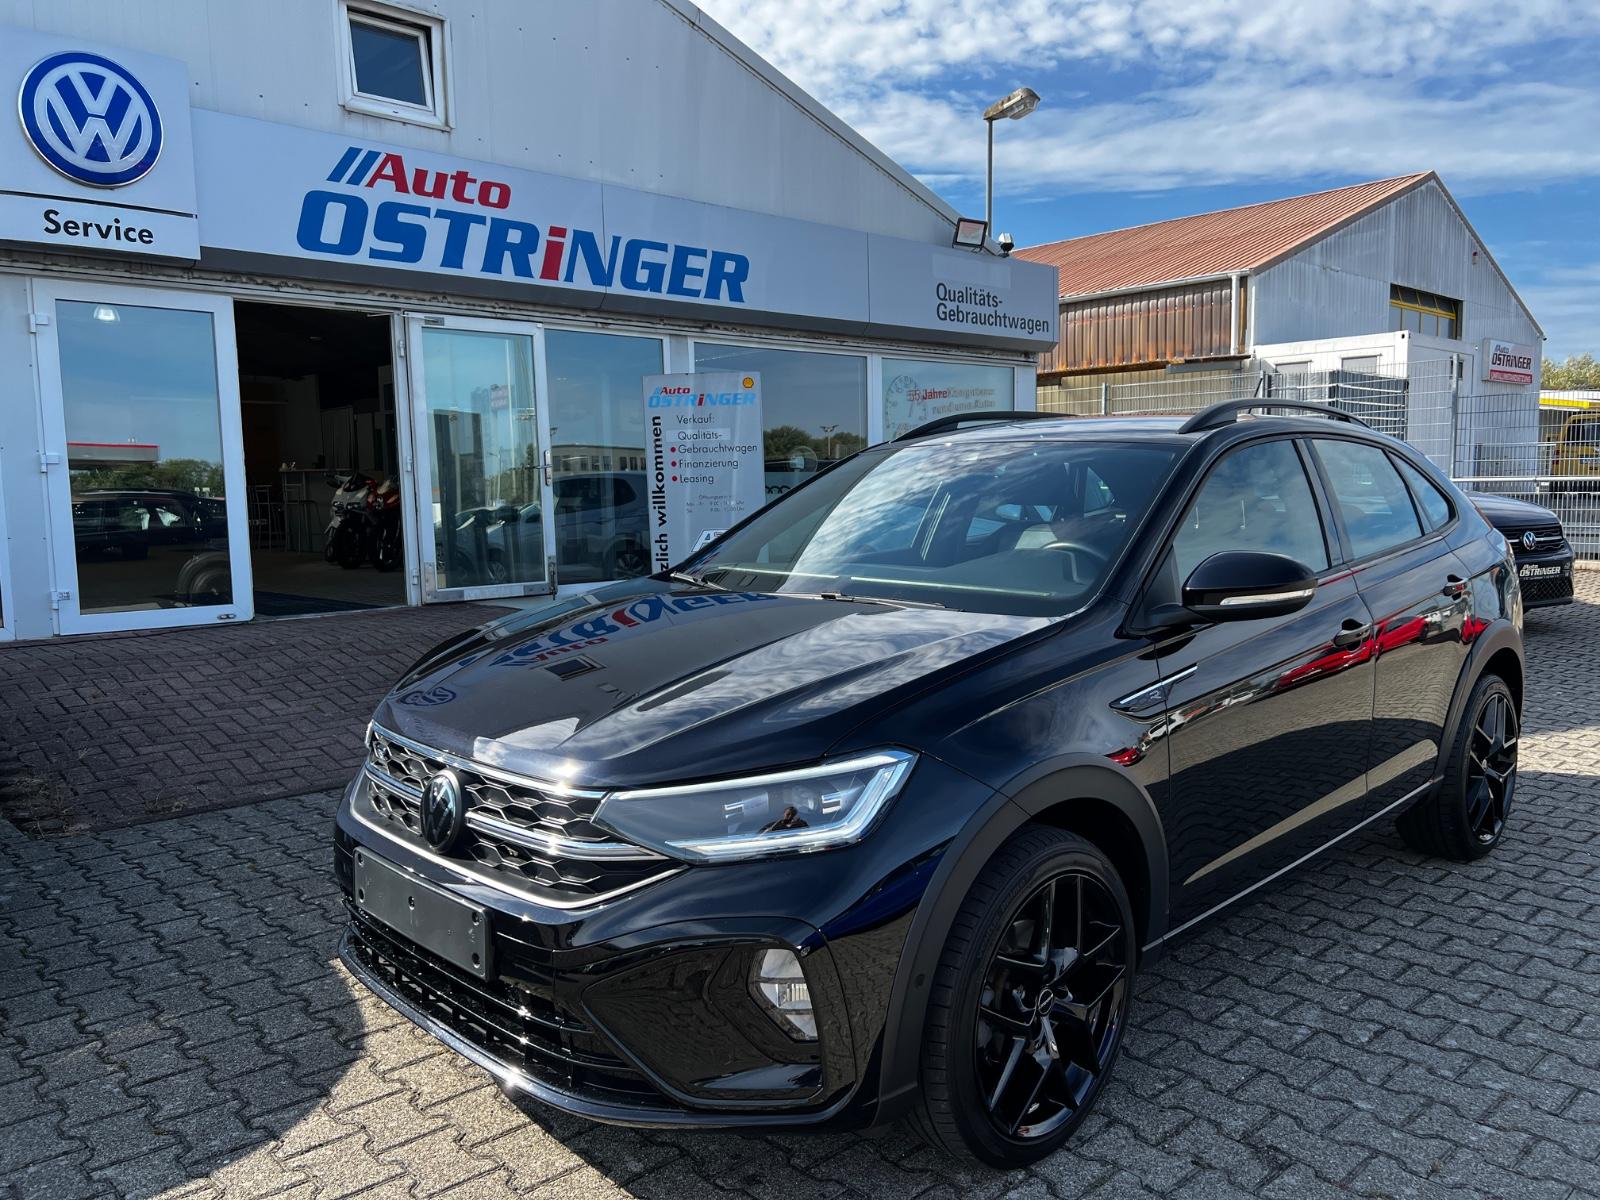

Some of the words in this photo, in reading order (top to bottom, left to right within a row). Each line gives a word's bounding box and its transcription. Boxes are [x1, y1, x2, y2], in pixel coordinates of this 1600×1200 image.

[365, 152, 511, 210] Auto
[43, 209, 154, 244] Service
[296, 190, 749, 303] OSTRiNGER
[936, 282, 1003, 308] Qualitäts-
[936, 302, 1049, 335] Gebrauchtwagen
[660, 386, 690, 395] Auto
[922, 387, 948, 400] Jahre
[676, 414, 715, 425] Verkauf:
[677, 430, 723, 441] Qualitäts-
[678, 443, 758, 455] Gebrauchtwagen
[652, 416, 667, 527] willkommen
[679, 459, 739, 470] Finanzierung
[680, 473, 714, 484] Leasing
[655, 533, 670, 574] zlich
